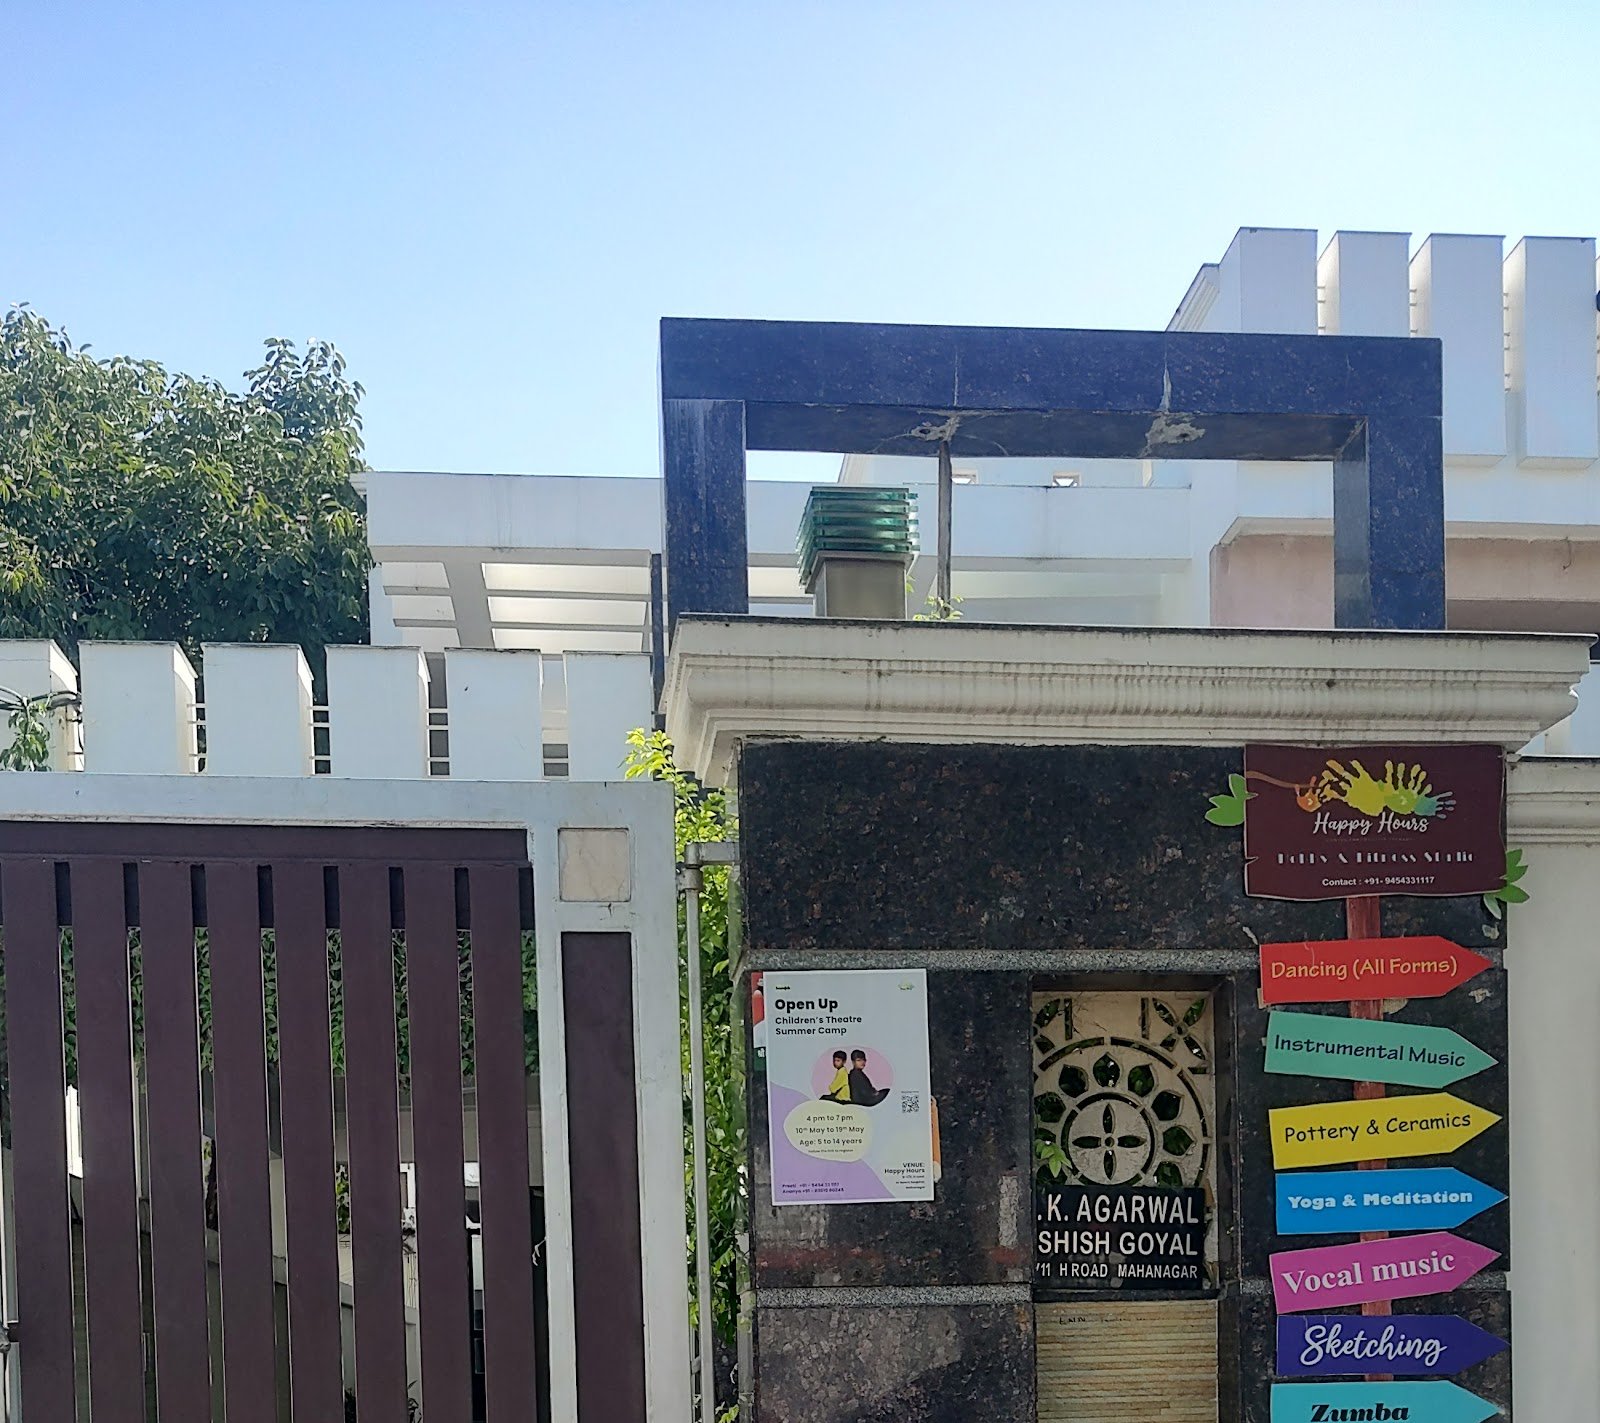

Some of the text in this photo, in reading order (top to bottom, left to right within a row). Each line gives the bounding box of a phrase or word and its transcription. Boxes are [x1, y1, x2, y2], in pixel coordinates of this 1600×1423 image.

[1313, 811, 1429, 835] Happy Hours
[1322, 878, 1357, 886] Contact
[1385, 876, 1435, 885] 9454331117
[1271, 955, 1458, 980] Dancing (All Forms)
[775, 998, 838, 1013] Open Up
[775, 1027, 847, 1036] Summer Camp
[1275, 1034, 1466, 1067] Instrumental Music
[1284, 1113, 1471, 1143] Pottery & Ceramics
[1077, 1193, 1199, 1224] AGARWAL
[1288, 1190, 1473, 1211] Yoga & Meditation
[1119, 1231, 1198, 1256] GOYAL
[1118, 1263, 1198, 1279] MAHANAGAR
[1281, 1250, 1456, 1294] Vocal music
[1300, 1324, 1447, 1367] Sketching
[1310, 1403, 1411, 1423] Zumba
